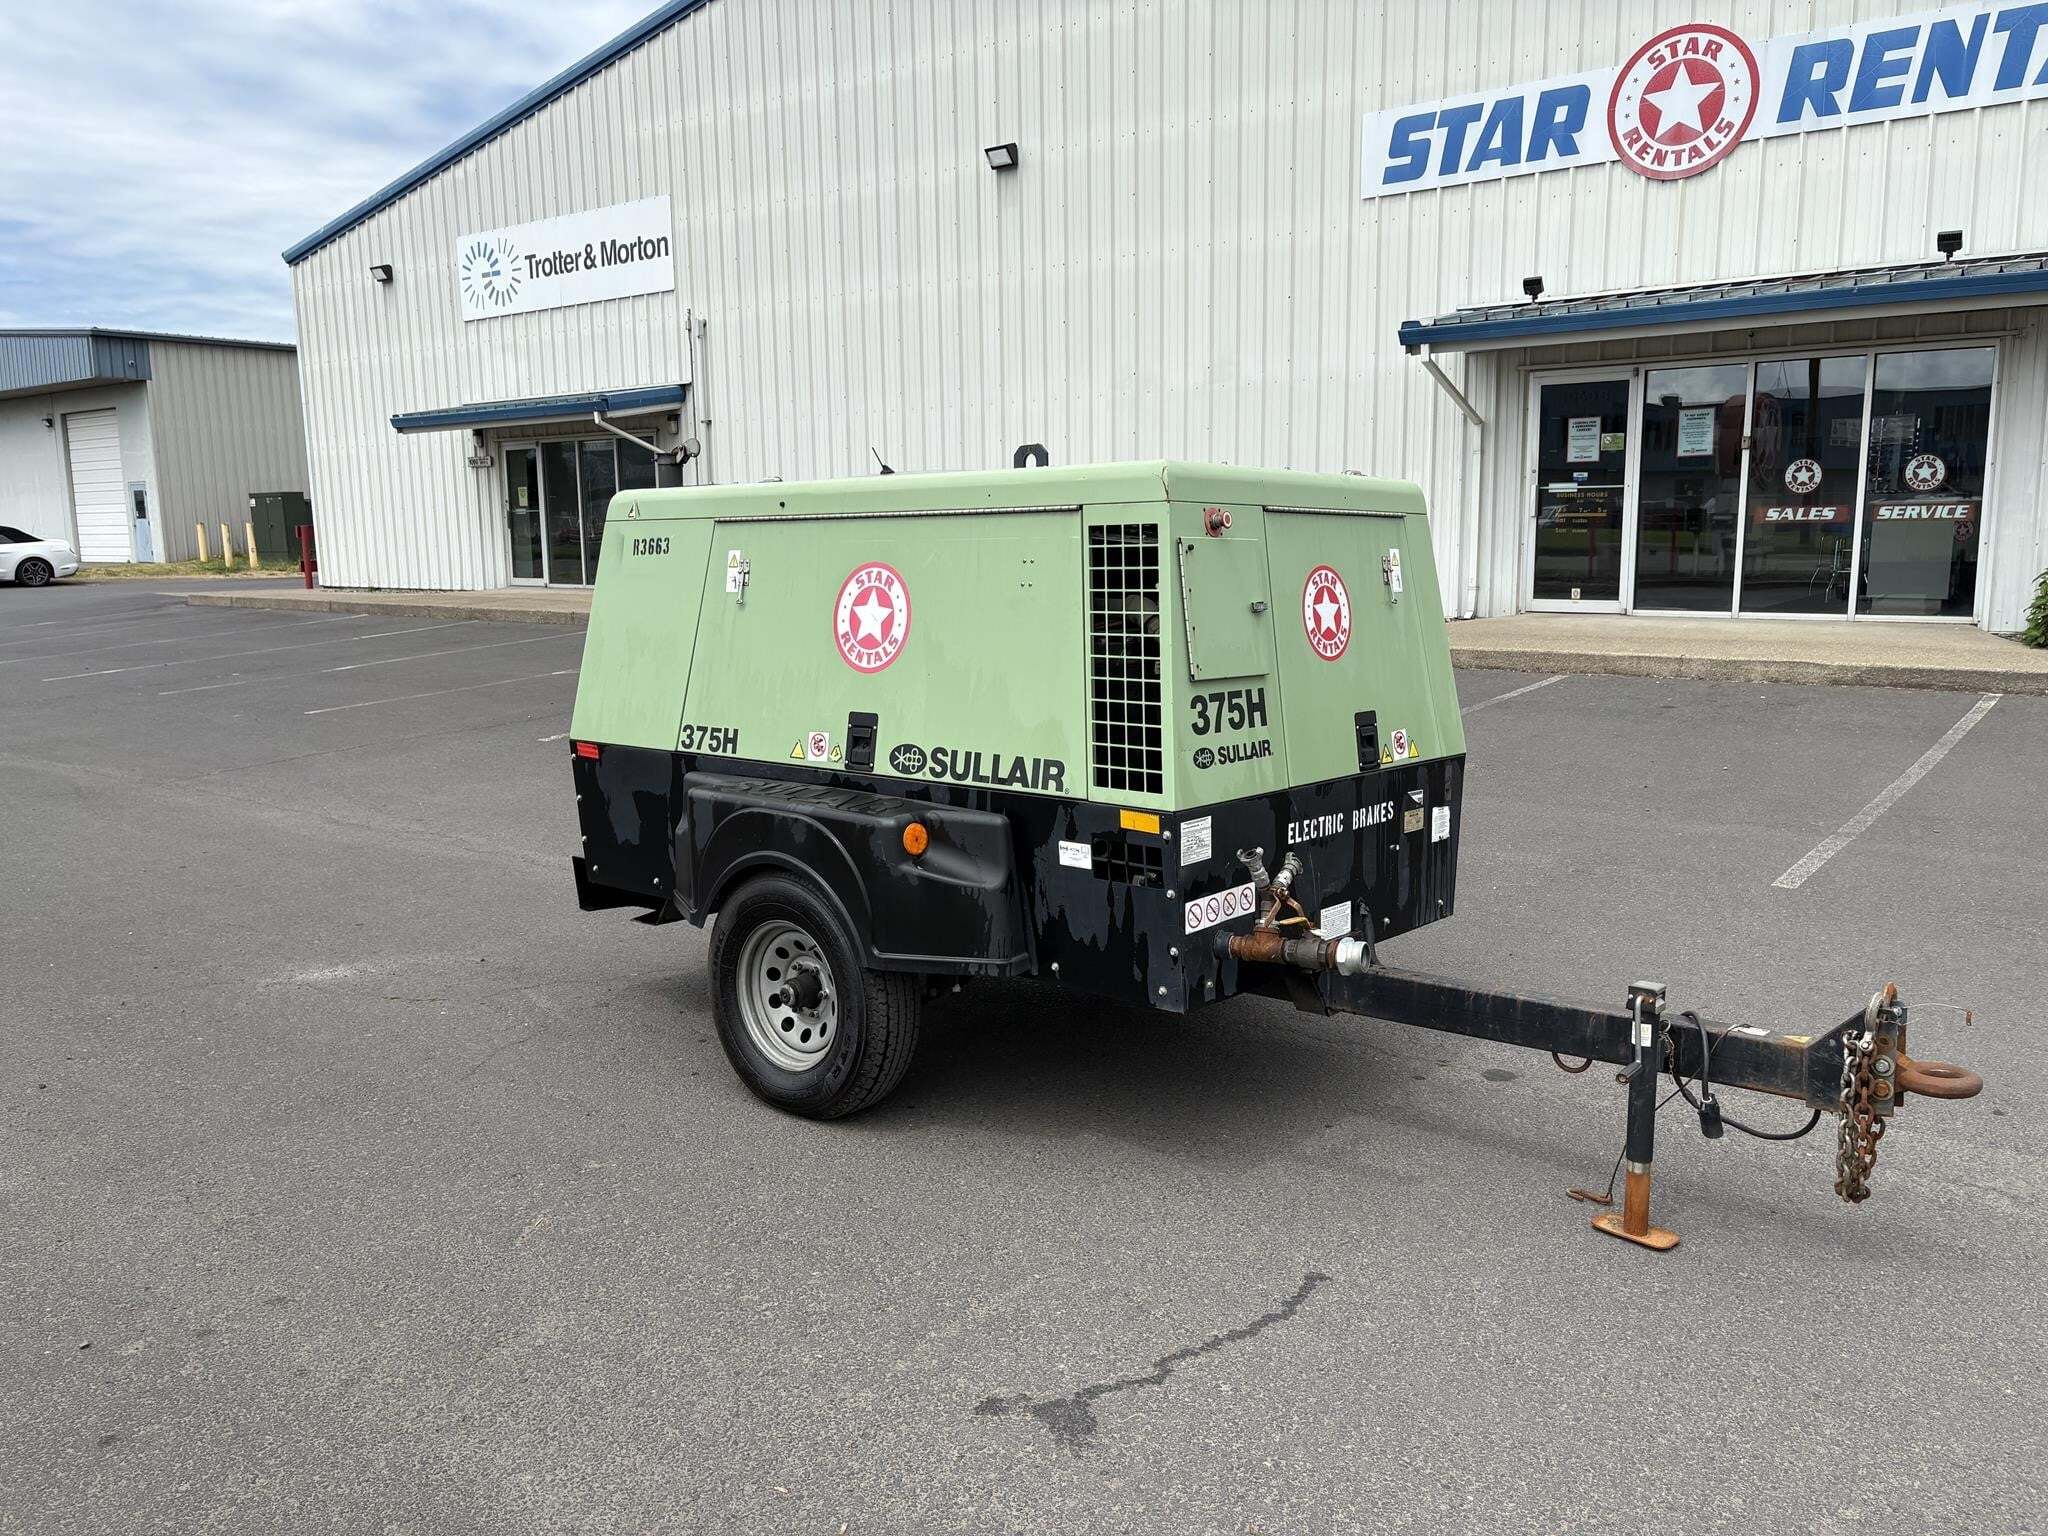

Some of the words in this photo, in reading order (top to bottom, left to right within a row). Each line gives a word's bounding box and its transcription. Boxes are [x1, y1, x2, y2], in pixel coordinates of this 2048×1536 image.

[1647, 36, 1724, 71] STAR
[1775, 2, 2048, 124] RENT
[1381, 84, 1591, 185] STAR
[1622, 117, 1736, 168] RENTALS
[525, 250, 581, 280] Trotter
[584, 243, 597, 271] &
[600, 235, 669, 267] Morton
[1915, 455, 1938, 464] STAR
[1765, 507, 1837, 521] SALES
[1876, 504, 1970, 520] SERVICE
[633, 537, 670, 556] R3663
[855, 565, 895, 593] STAR
[1311, 572, 1337, 591] STAR
[840, 630, 899, 665] RENTALS
[1310, 626, 1348, 654] RENTALS
[1190, 687, 1268, 736] 375H
[680, 723, 739, 755] 375H
[1217, 739, 1271, 765] SULLAIR
[928, 746, 1066, 793] SULLAIR
[1287, 812, 1345, 845] ELECTRIC
[1352, 800, 1394, 831] BRAKES
